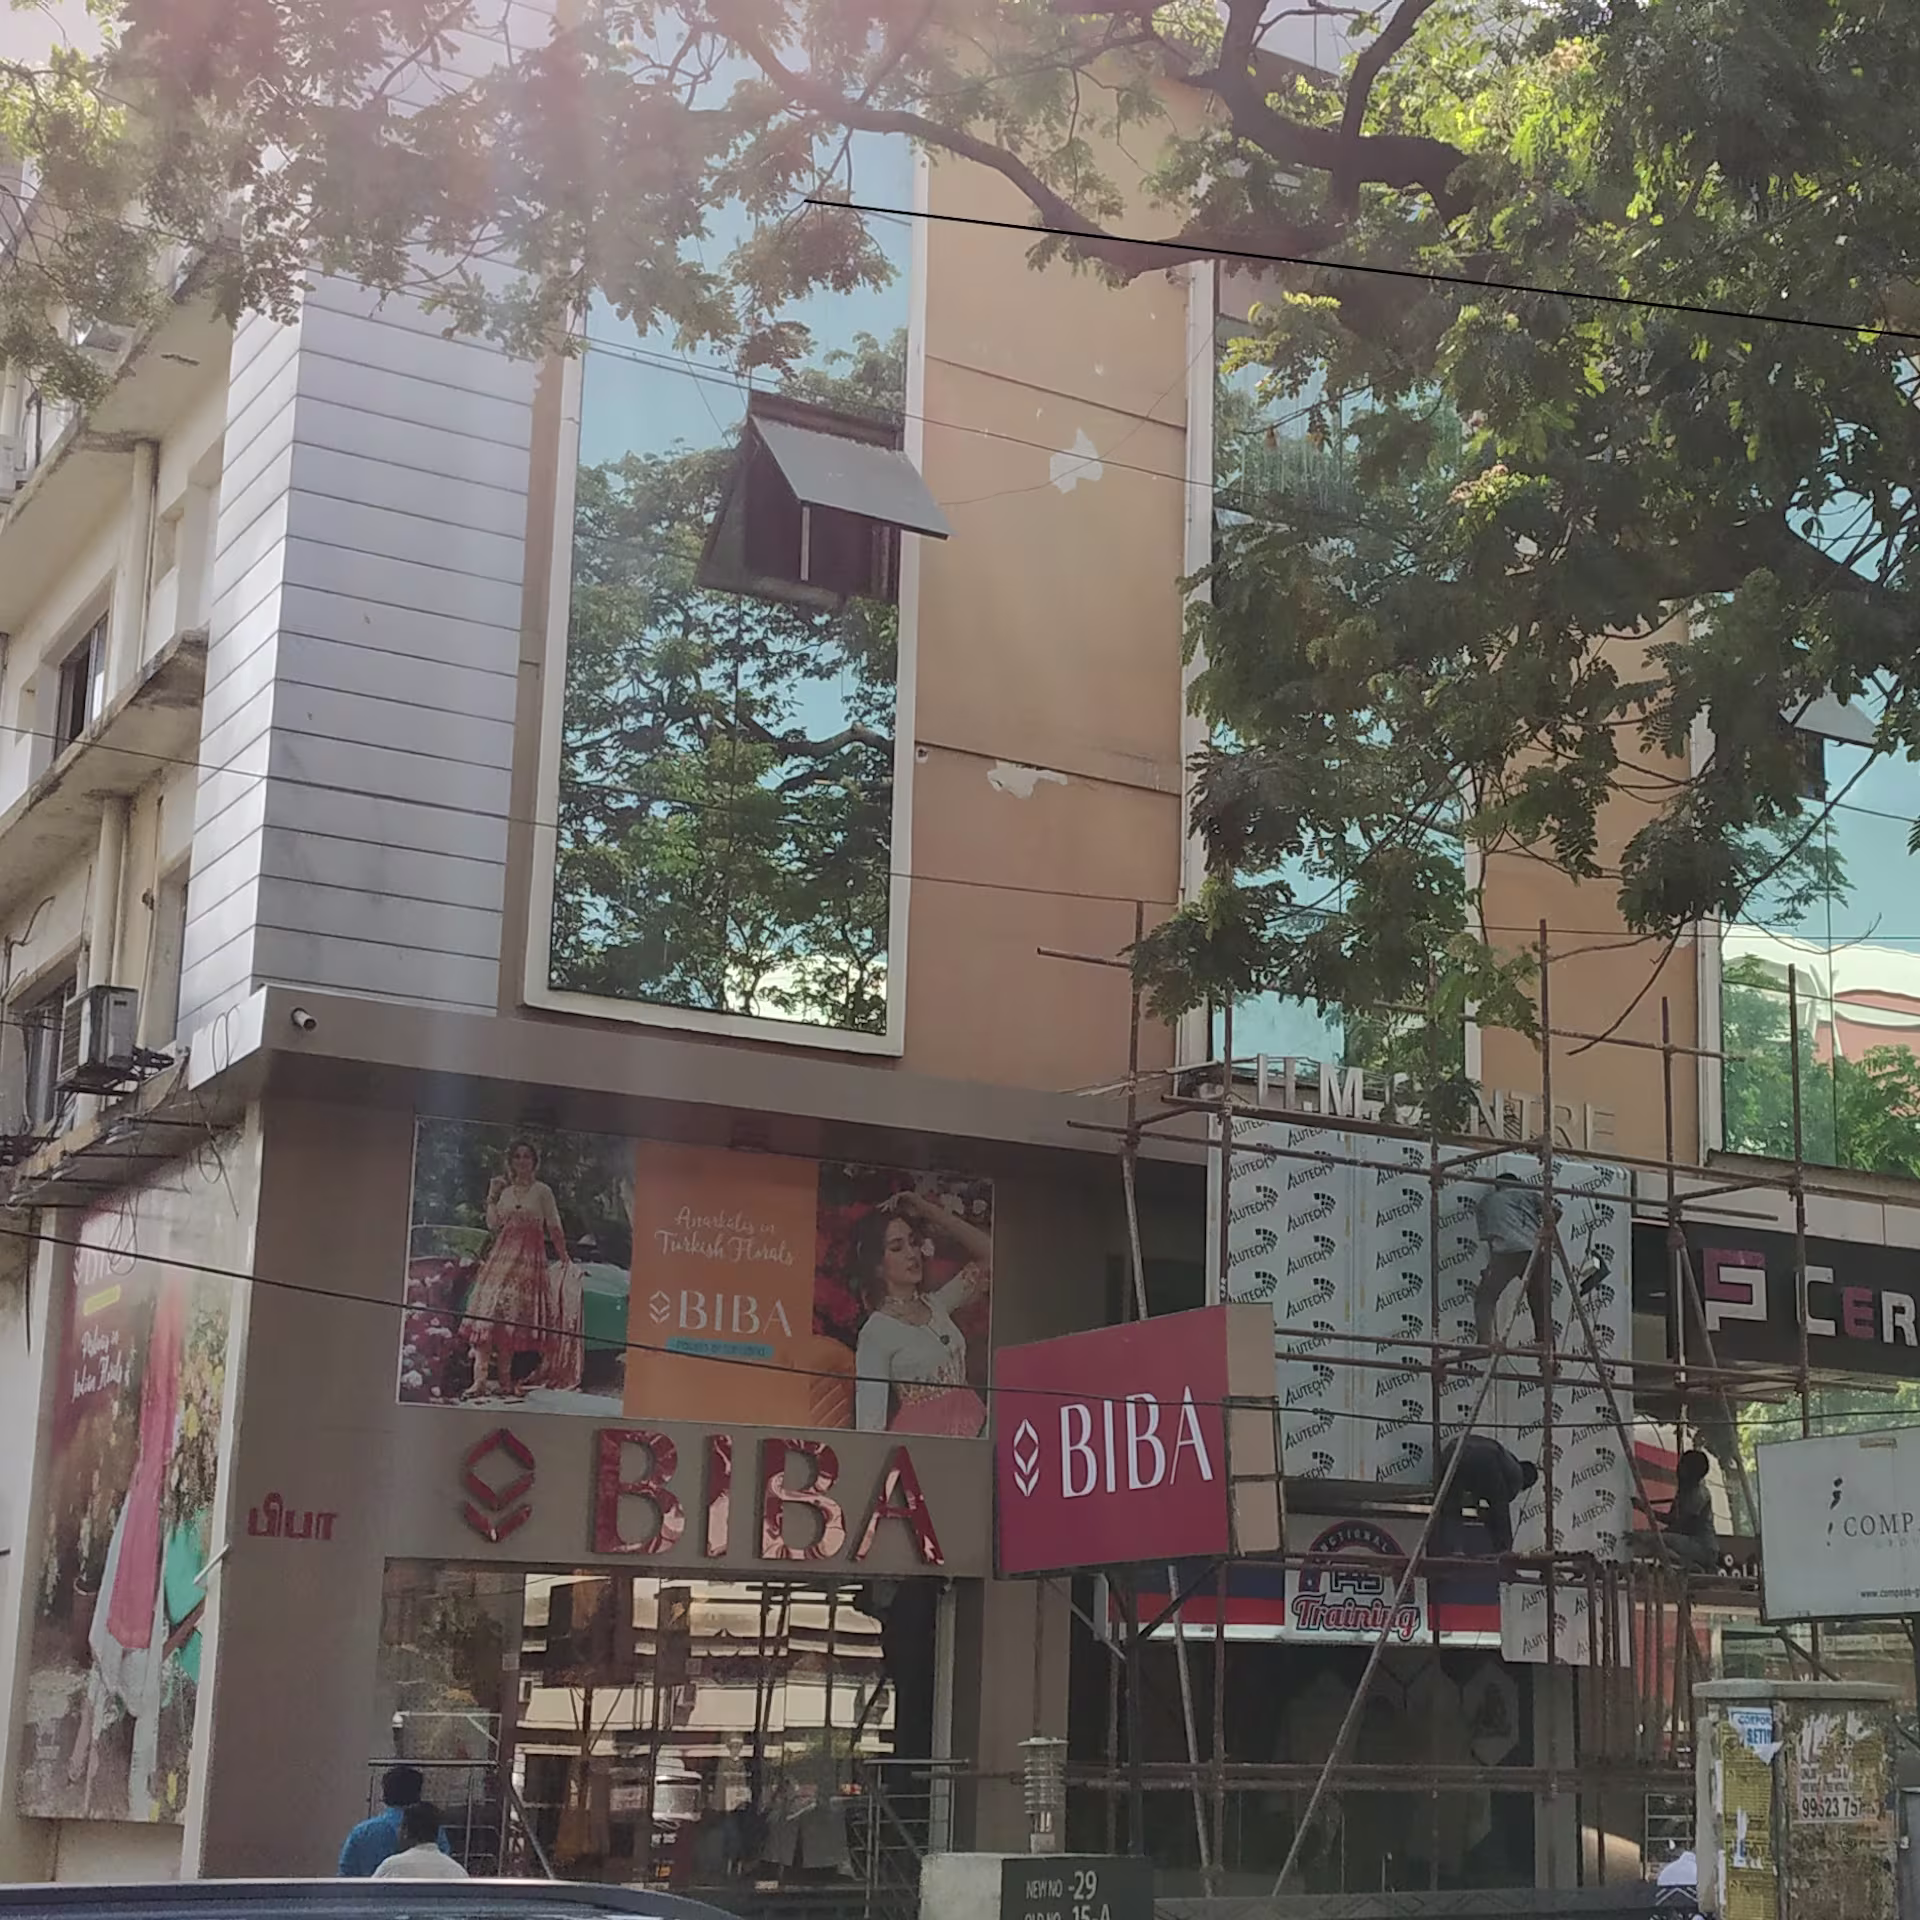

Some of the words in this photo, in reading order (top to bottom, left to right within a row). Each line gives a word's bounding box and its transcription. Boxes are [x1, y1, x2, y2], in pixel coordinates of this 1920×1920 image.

[654, 1230, 724, 1260] Turkish
[728, 1237, 794, 1266] Florals
[679, 1290, 793, 1338] BIBA
[1060, 1385, 1213, 1499] BIBA
[591, 1427, 946, 1566] BIBA
[1843, 1512, 1920, 1538] COMP
[1292, 1592, 1420, 1642] Training
